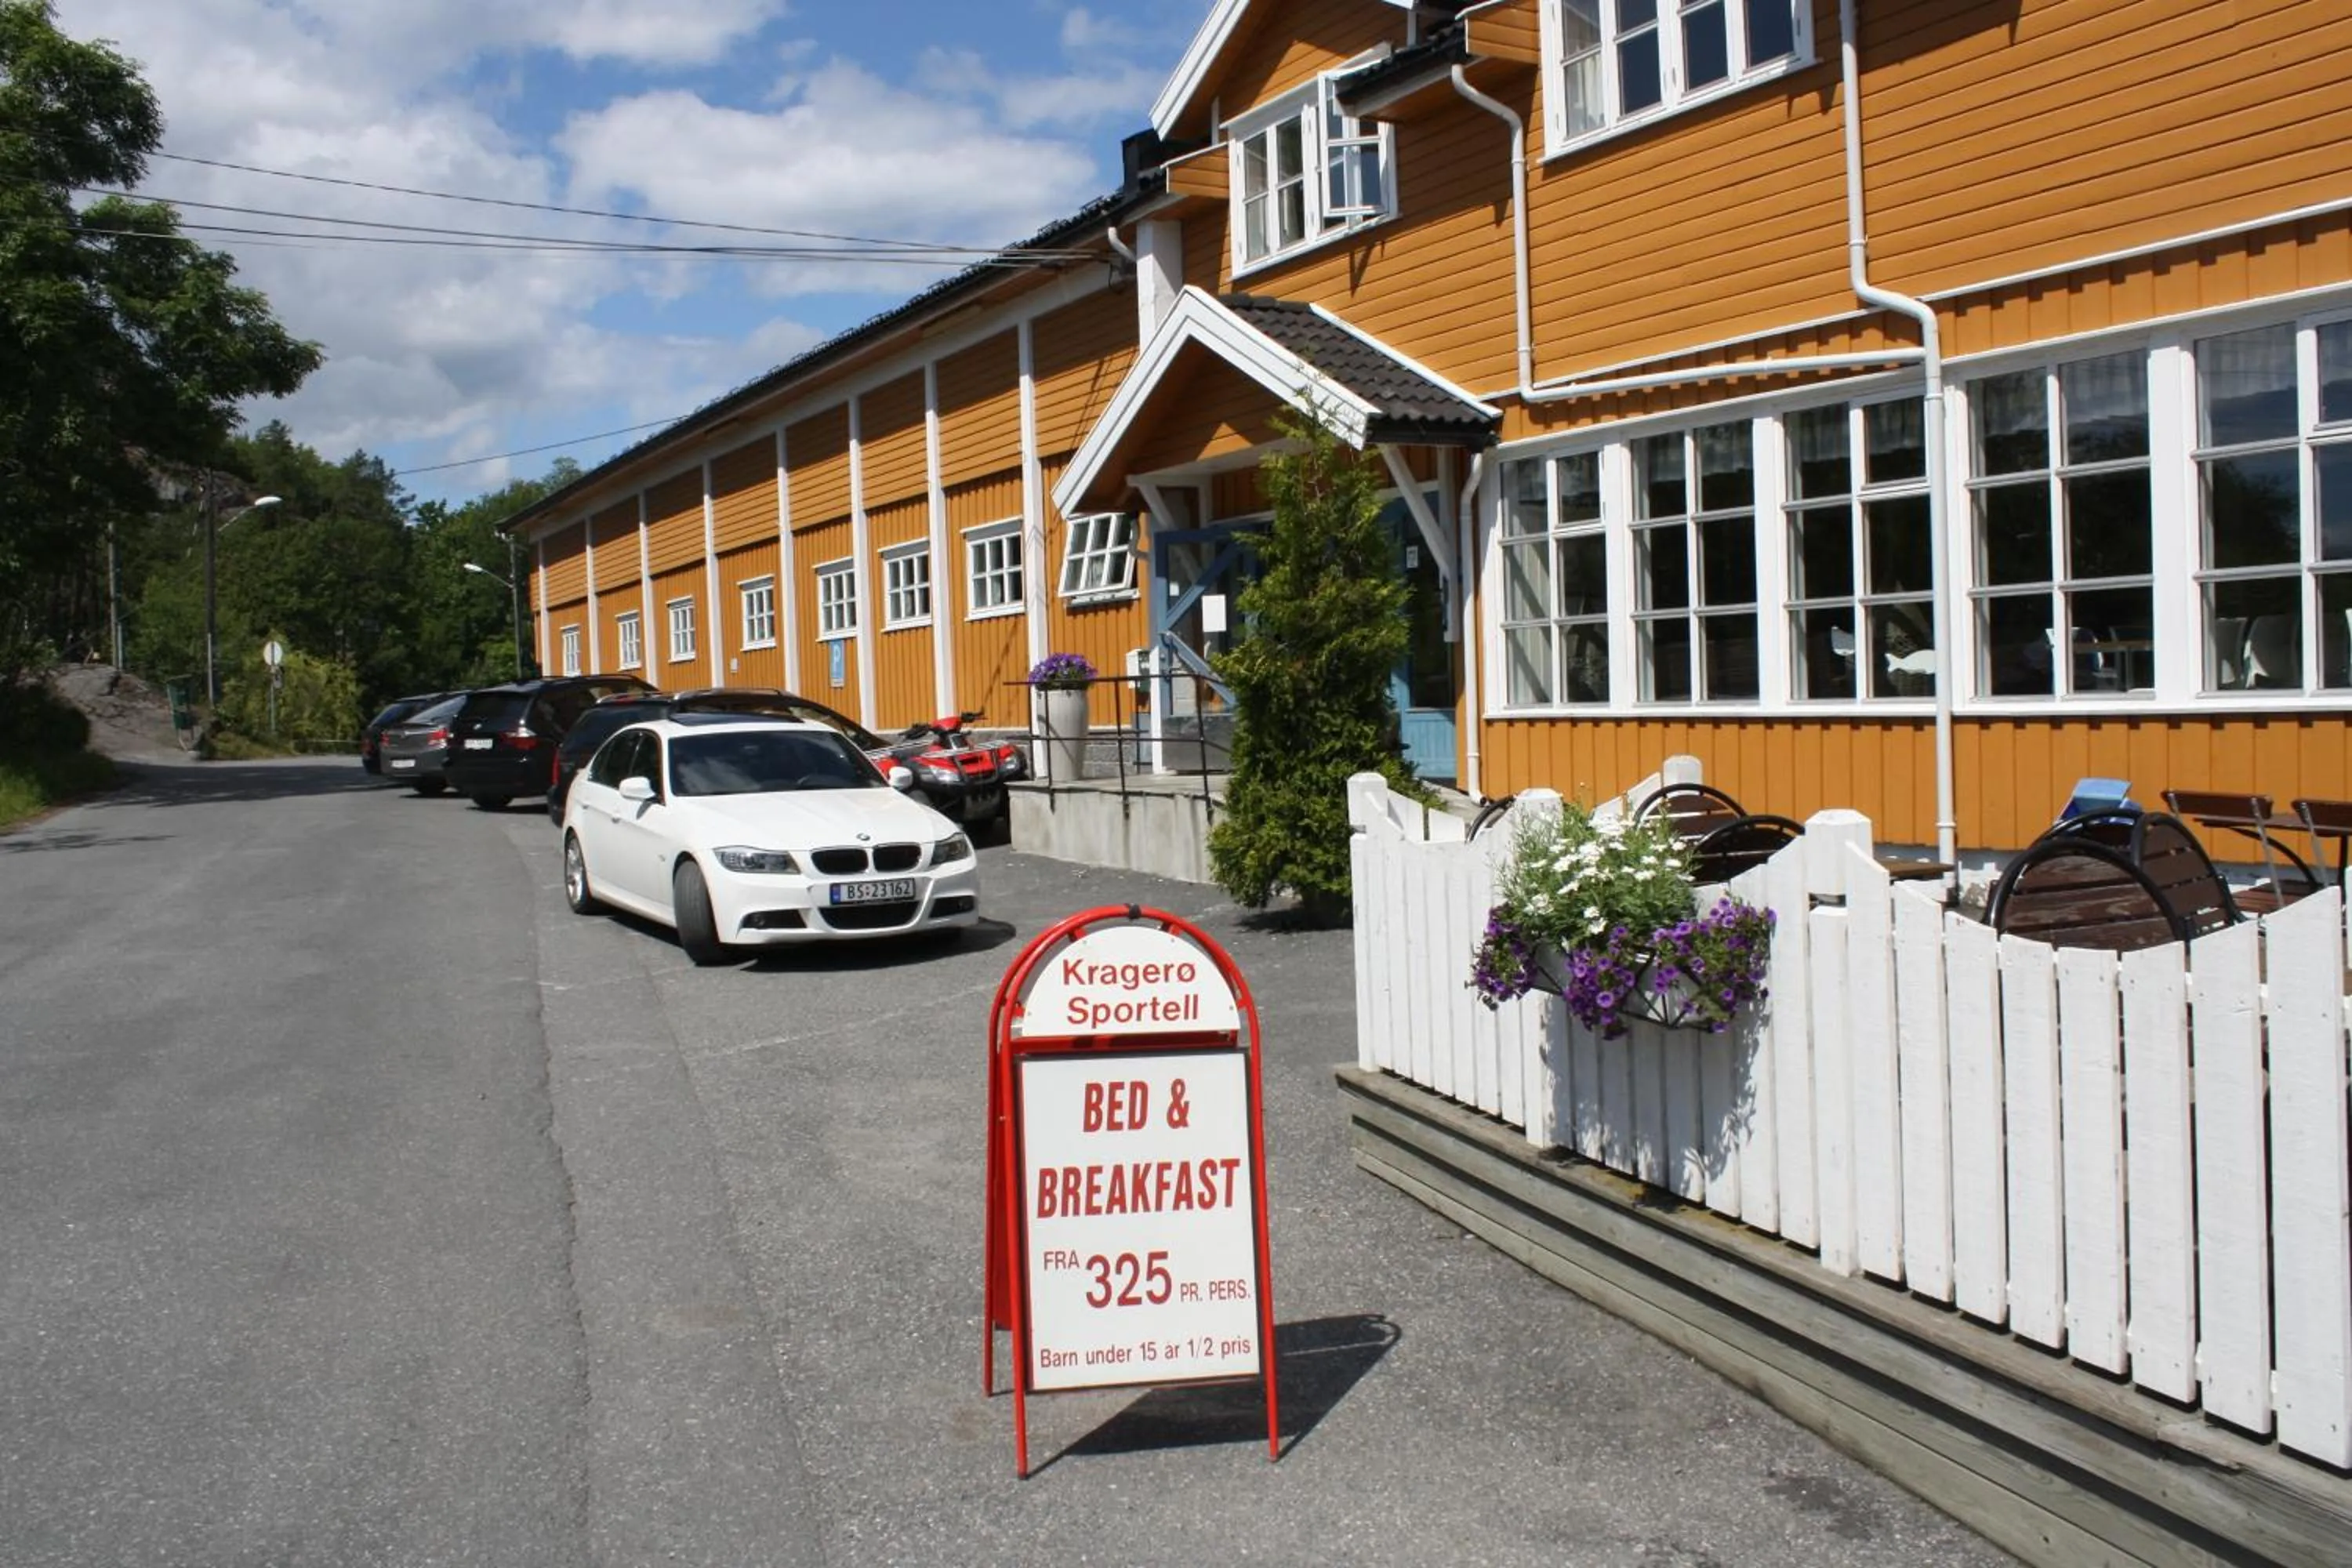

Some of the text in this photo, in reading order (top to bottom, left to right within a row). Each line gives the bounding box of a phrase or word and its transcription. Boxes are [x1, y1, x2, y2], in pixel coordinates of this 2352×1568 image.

[1062, 959, 1196, 990] Kragerø
[1067, 994, 1199, 1029] Sportell
[1083, 1078, 1190, 1133] BED &
[1036, 1158, 1241, 1219] BREAKFAST
[1044, 1250, 1251, 1308] FRA 325 PR. PERS.
[1040, 1348, 1078, 1368] Barn
[1086, 1345, 1132, 1365] under
[1139, 1341, 1157, 1361] 15
[1187, 1336, 1214, 1359] 1/2
[1221, 1335, 1251, 1359] pris
